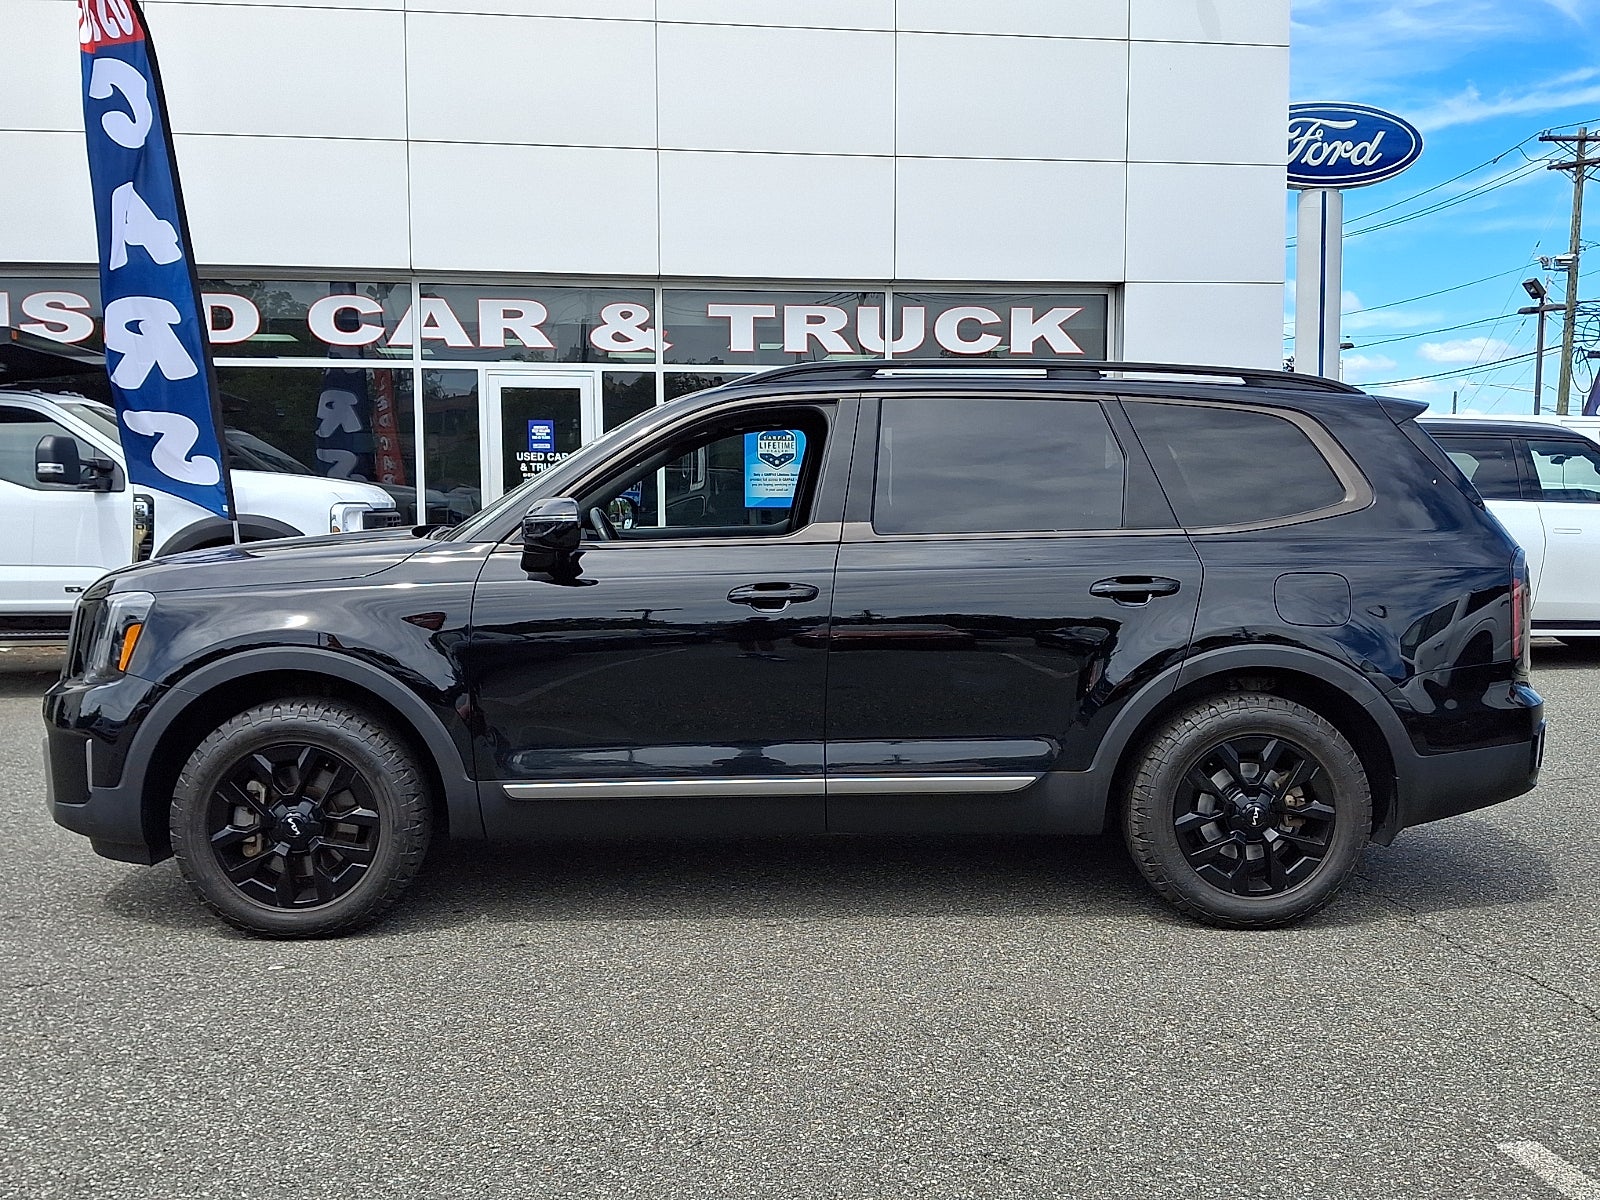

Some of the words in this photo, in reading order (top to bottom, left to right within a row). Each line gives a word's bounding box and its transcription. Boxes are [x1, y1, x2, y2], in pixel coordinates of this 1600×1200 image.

[1287, 117, 1386, 167] Ford
[0, 290, 261, 346] SD
[308, 294, 556, 349] CAR
[590, 302, 673, 352] &
[708, 303, 1086, 355] TRUCK
[760, 441, 795, 449] LIFETIME
[516, 451, 545, 461] USED
[520, 462, 528, 472] &
